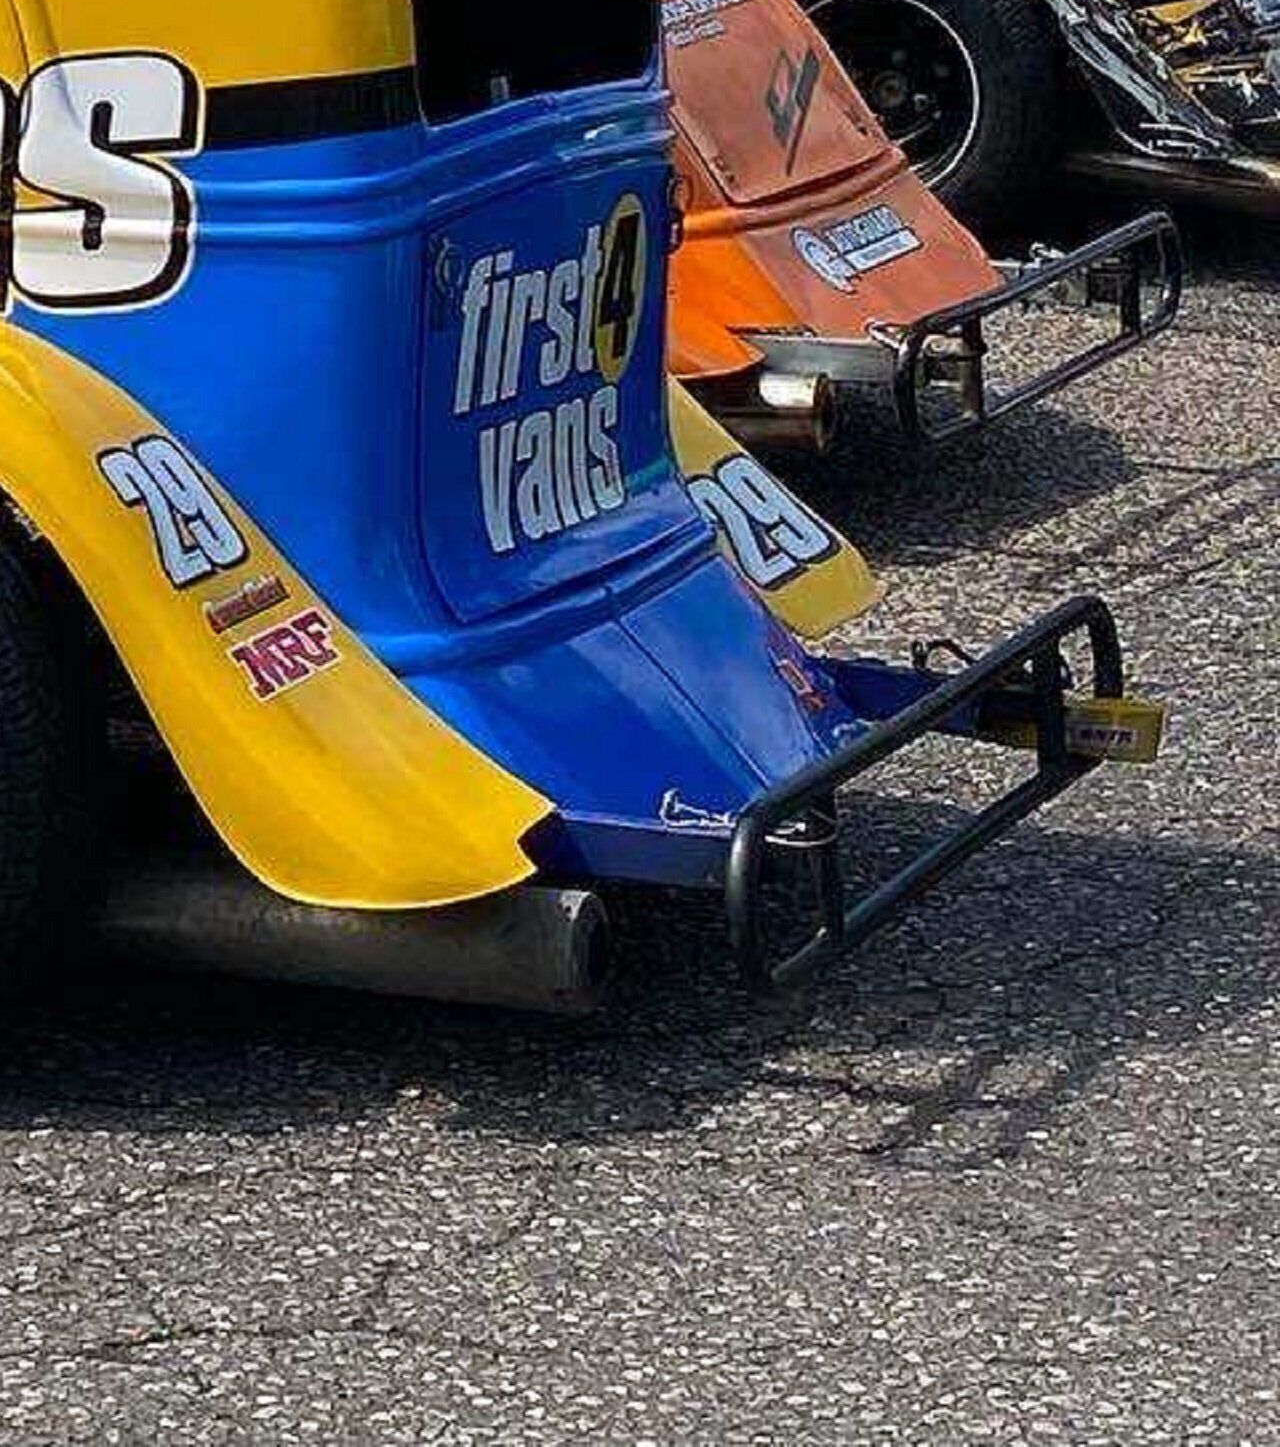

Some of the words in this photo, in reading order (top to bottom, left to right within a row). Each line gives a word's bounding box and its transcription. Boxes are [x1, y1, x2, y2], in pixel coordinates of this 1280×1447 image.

[96, 434, 249, 590] 29
[478, 384, 626, 554] vans
[686, 455, 838, 590] 29
[226, 608, 340, 701] MRF
